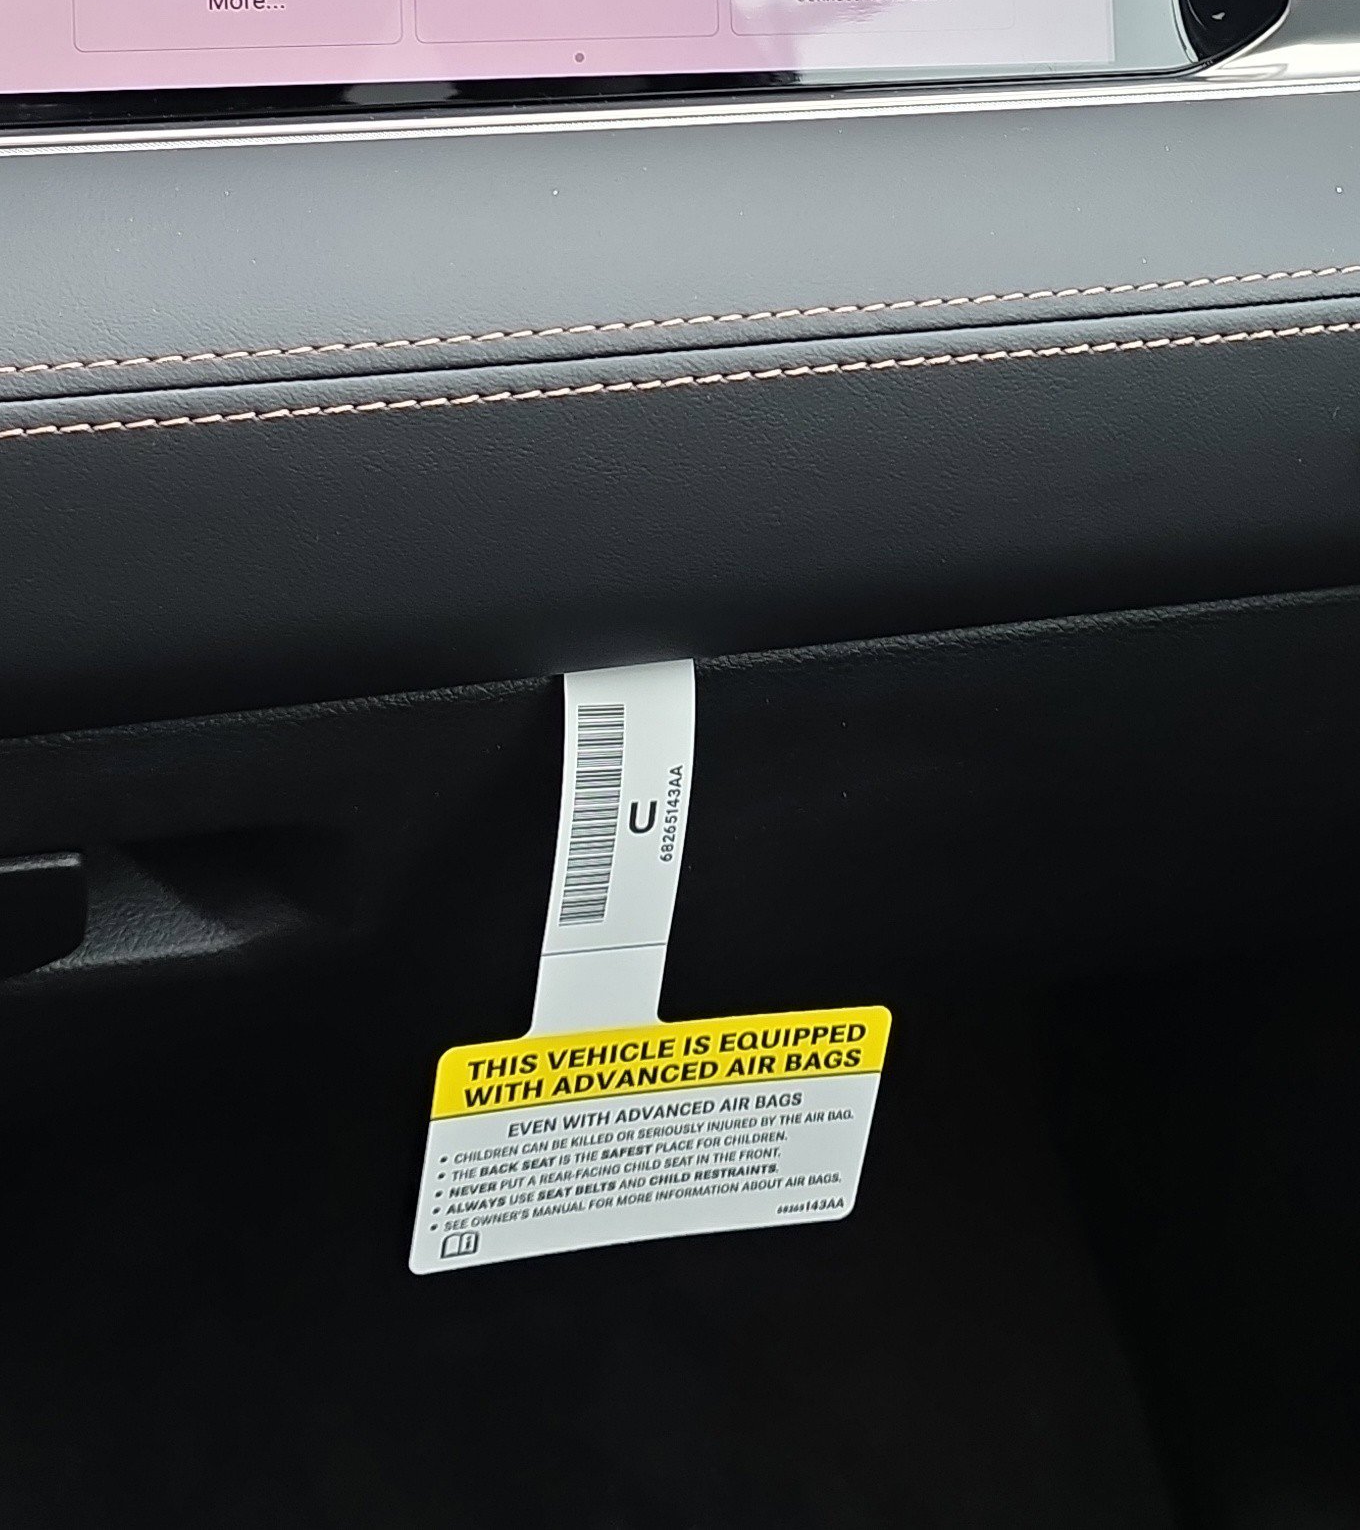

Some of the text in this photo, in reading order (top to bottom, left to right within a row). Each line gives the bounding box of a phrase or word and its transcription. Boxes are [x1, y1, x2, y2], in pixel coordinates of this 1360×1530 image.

[629, 800, 657, 834] U
[660, 765, 683, 862] 68265143AA
[464, 1048, 862, 1108] WITH ADVANCED AIR BAGS
[468, 1023, 867, 1082] THIS VEHICLE IS EQUIPPED
[454, 1109, 854, 1165] CHILDREN CAN BE KILLED OR SERIOUSLY INJURED BY THE AIR BAG.
[507, 1092, 803, 1138] EVEN WITH ADVANCED AIR BAGS
[448, 1146, 781, 1199] NEVER PUT A REAR-FACING CHILD SEAT IN THE FRONT.
[452, 1131, 788, 1182] THE BACK SEAT IS THE SAFEST PLACE FOR CHILDREN.
[443, 1172, 841, 1232] SEE OWNER'S MANUAL FOR MORE INFORMATION ABOUT AIR BAGS.
[445, 1163, 779, 1215] ALWAYS USE SEAT BELTS AND CHILD RESTRAINTS.
